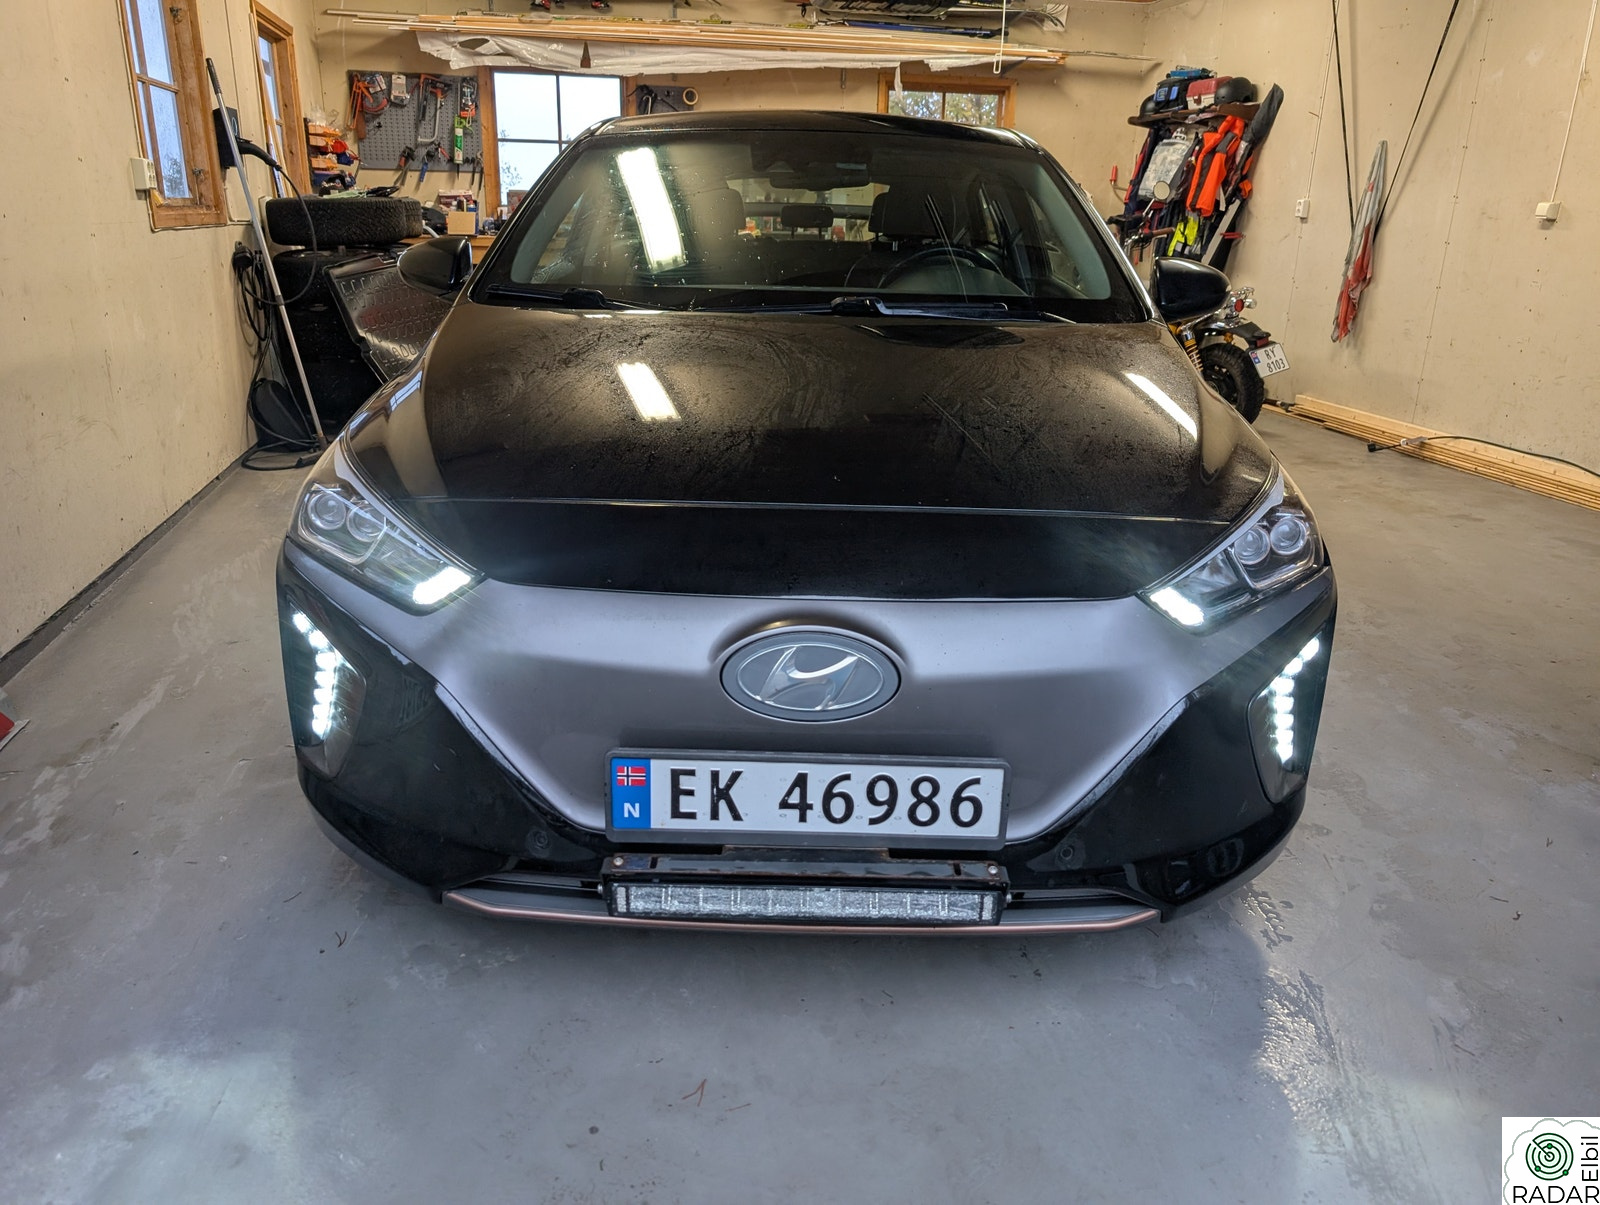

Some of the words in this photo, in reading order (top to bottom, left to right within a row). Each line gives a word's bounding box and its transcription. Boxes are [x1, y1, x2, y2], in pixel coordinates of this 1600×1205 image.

[1266, 358, 1286, 373] 8103
[670, 768, 743, 821] EK
[778, 772, 984, 828] 46986
[623, 802, 640, 818] N
